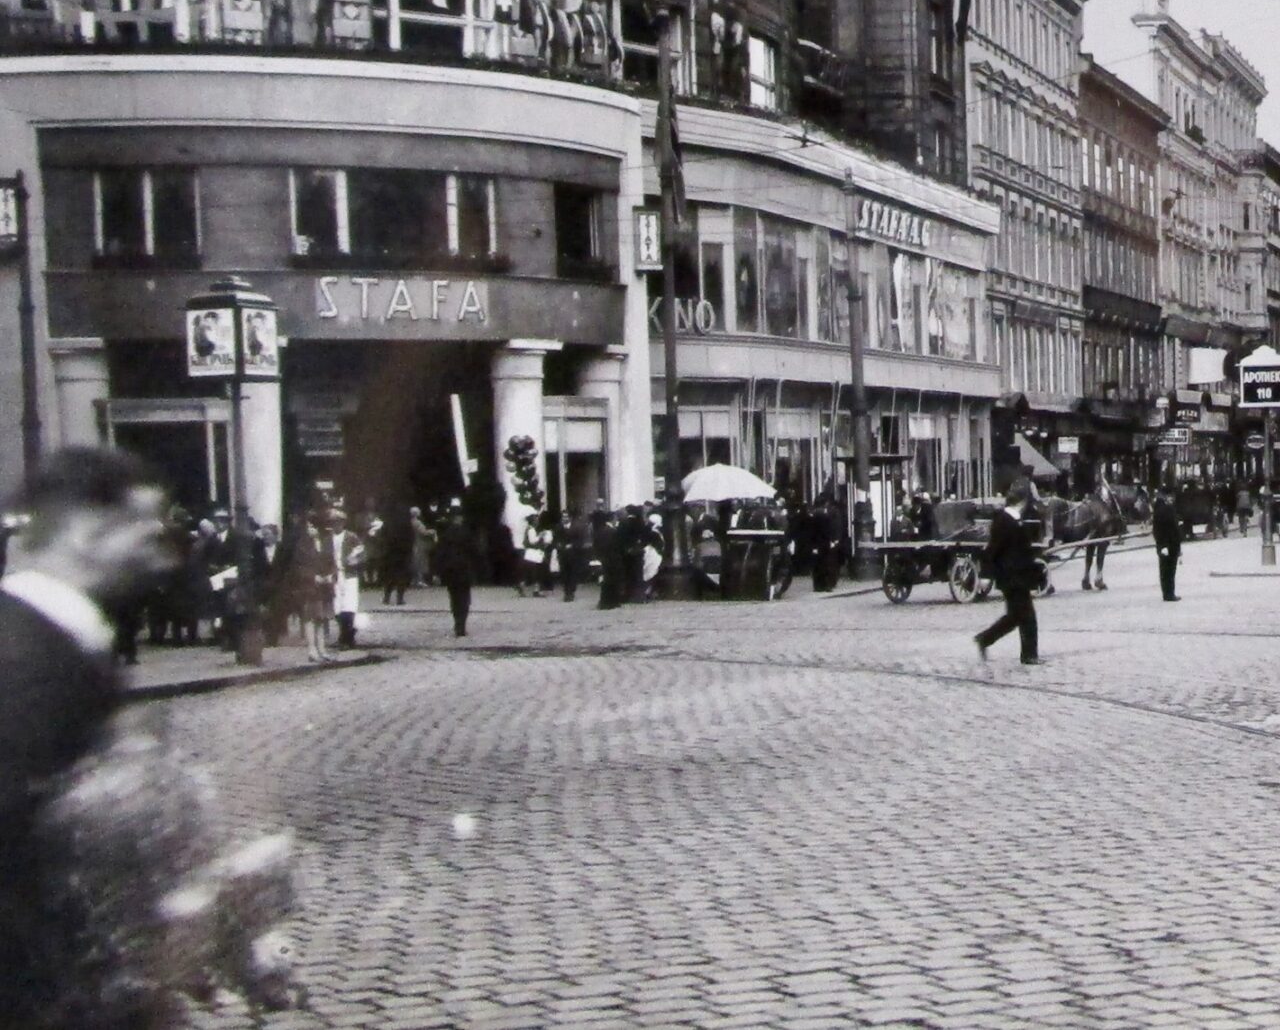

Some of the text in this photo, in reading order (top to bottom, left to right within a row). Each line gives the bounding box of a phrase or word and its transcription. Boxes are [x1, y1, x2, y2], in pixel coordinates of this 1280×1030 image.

[319, 277, 485, 320] STAFA
[648, 296, 716, 333] KNO
[1256, 388, 1272, 399] 110
